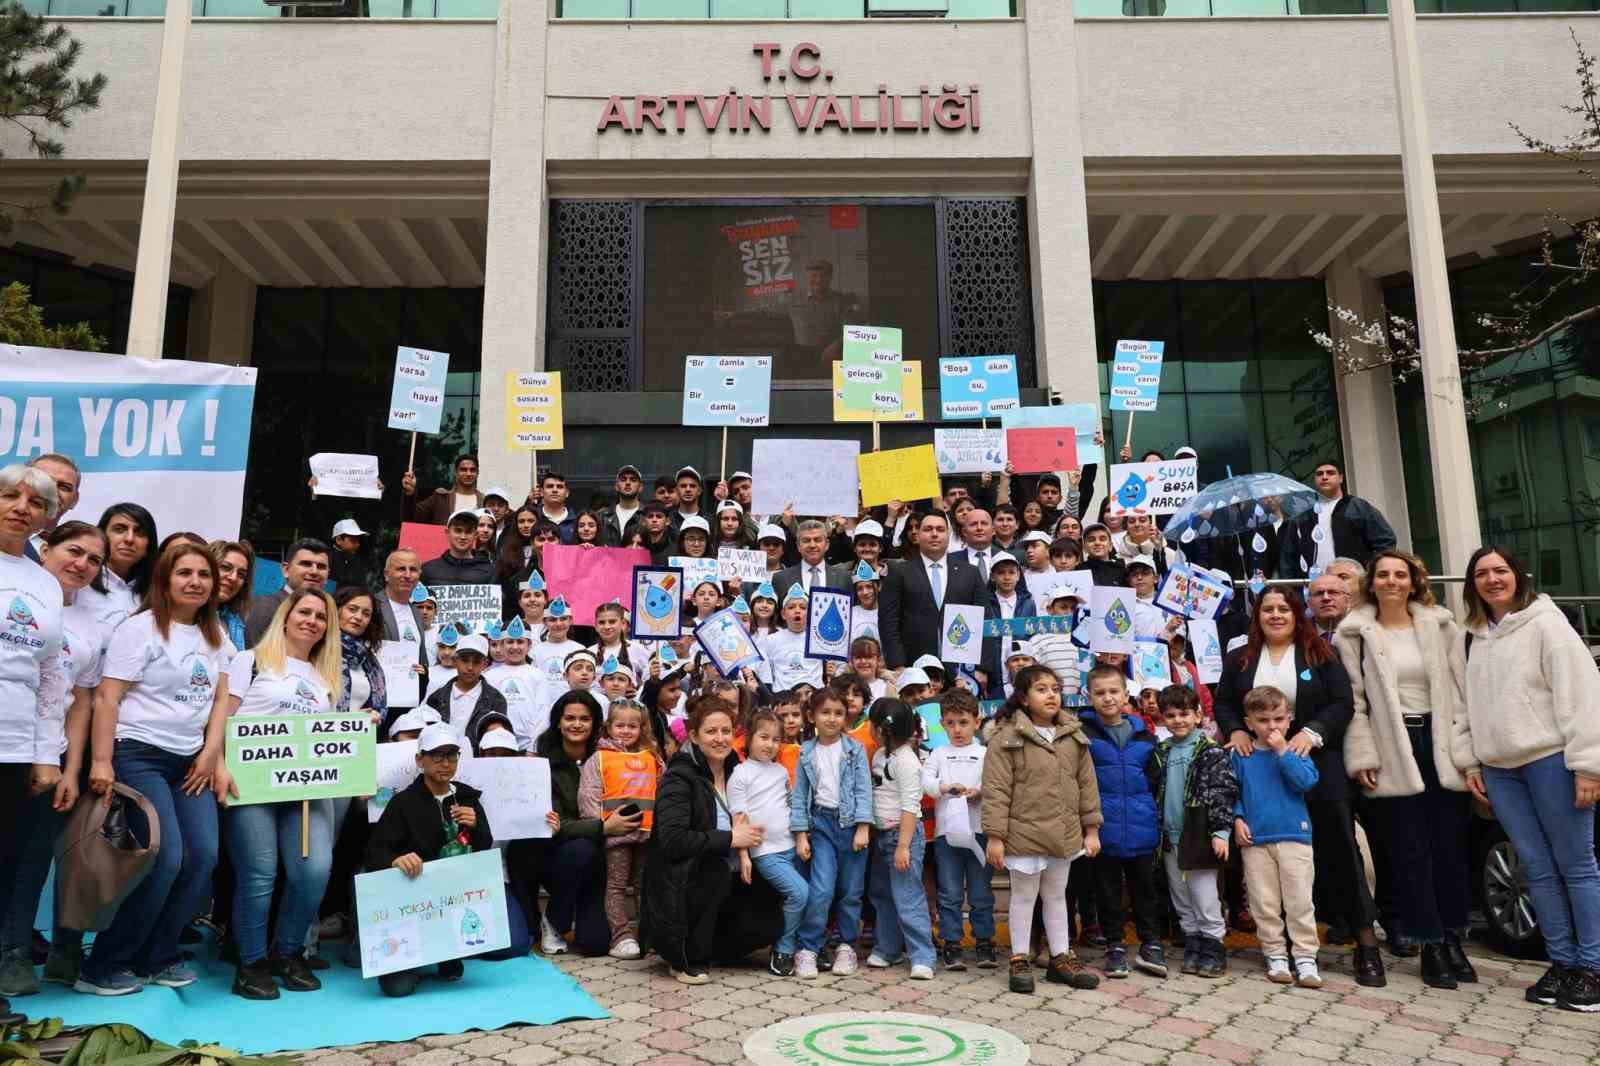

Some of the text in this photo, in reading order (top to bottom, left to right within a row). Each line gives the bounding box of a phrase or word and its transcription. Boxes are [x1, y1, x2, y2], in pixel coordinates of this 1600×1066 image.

[753, 42, 834, 81] T.C.
[597, 84, 980, 133] ARTVİN VALİLİĞİ
[739, 235, 790, 260] SEN
[399, 366, 426, 377] varsa
[412, 391, 439, 404] hayat
[689, 391, 702, 399] Bir
[710, 403, 736, 411] damla
[535, 415, 545, 423] de
[79, 397, 187, 457] YOK
[1158, 466, 1195, 481] SUYU
[1163, 482, 1194, 492] BOŞA
[238, 723, 288, 737] DAHA
[311, 721, 334, 733] AZ
[242, 742, 352, 761] DAHA ÇOK
[275, 768, 338, 785] YAŞAM
